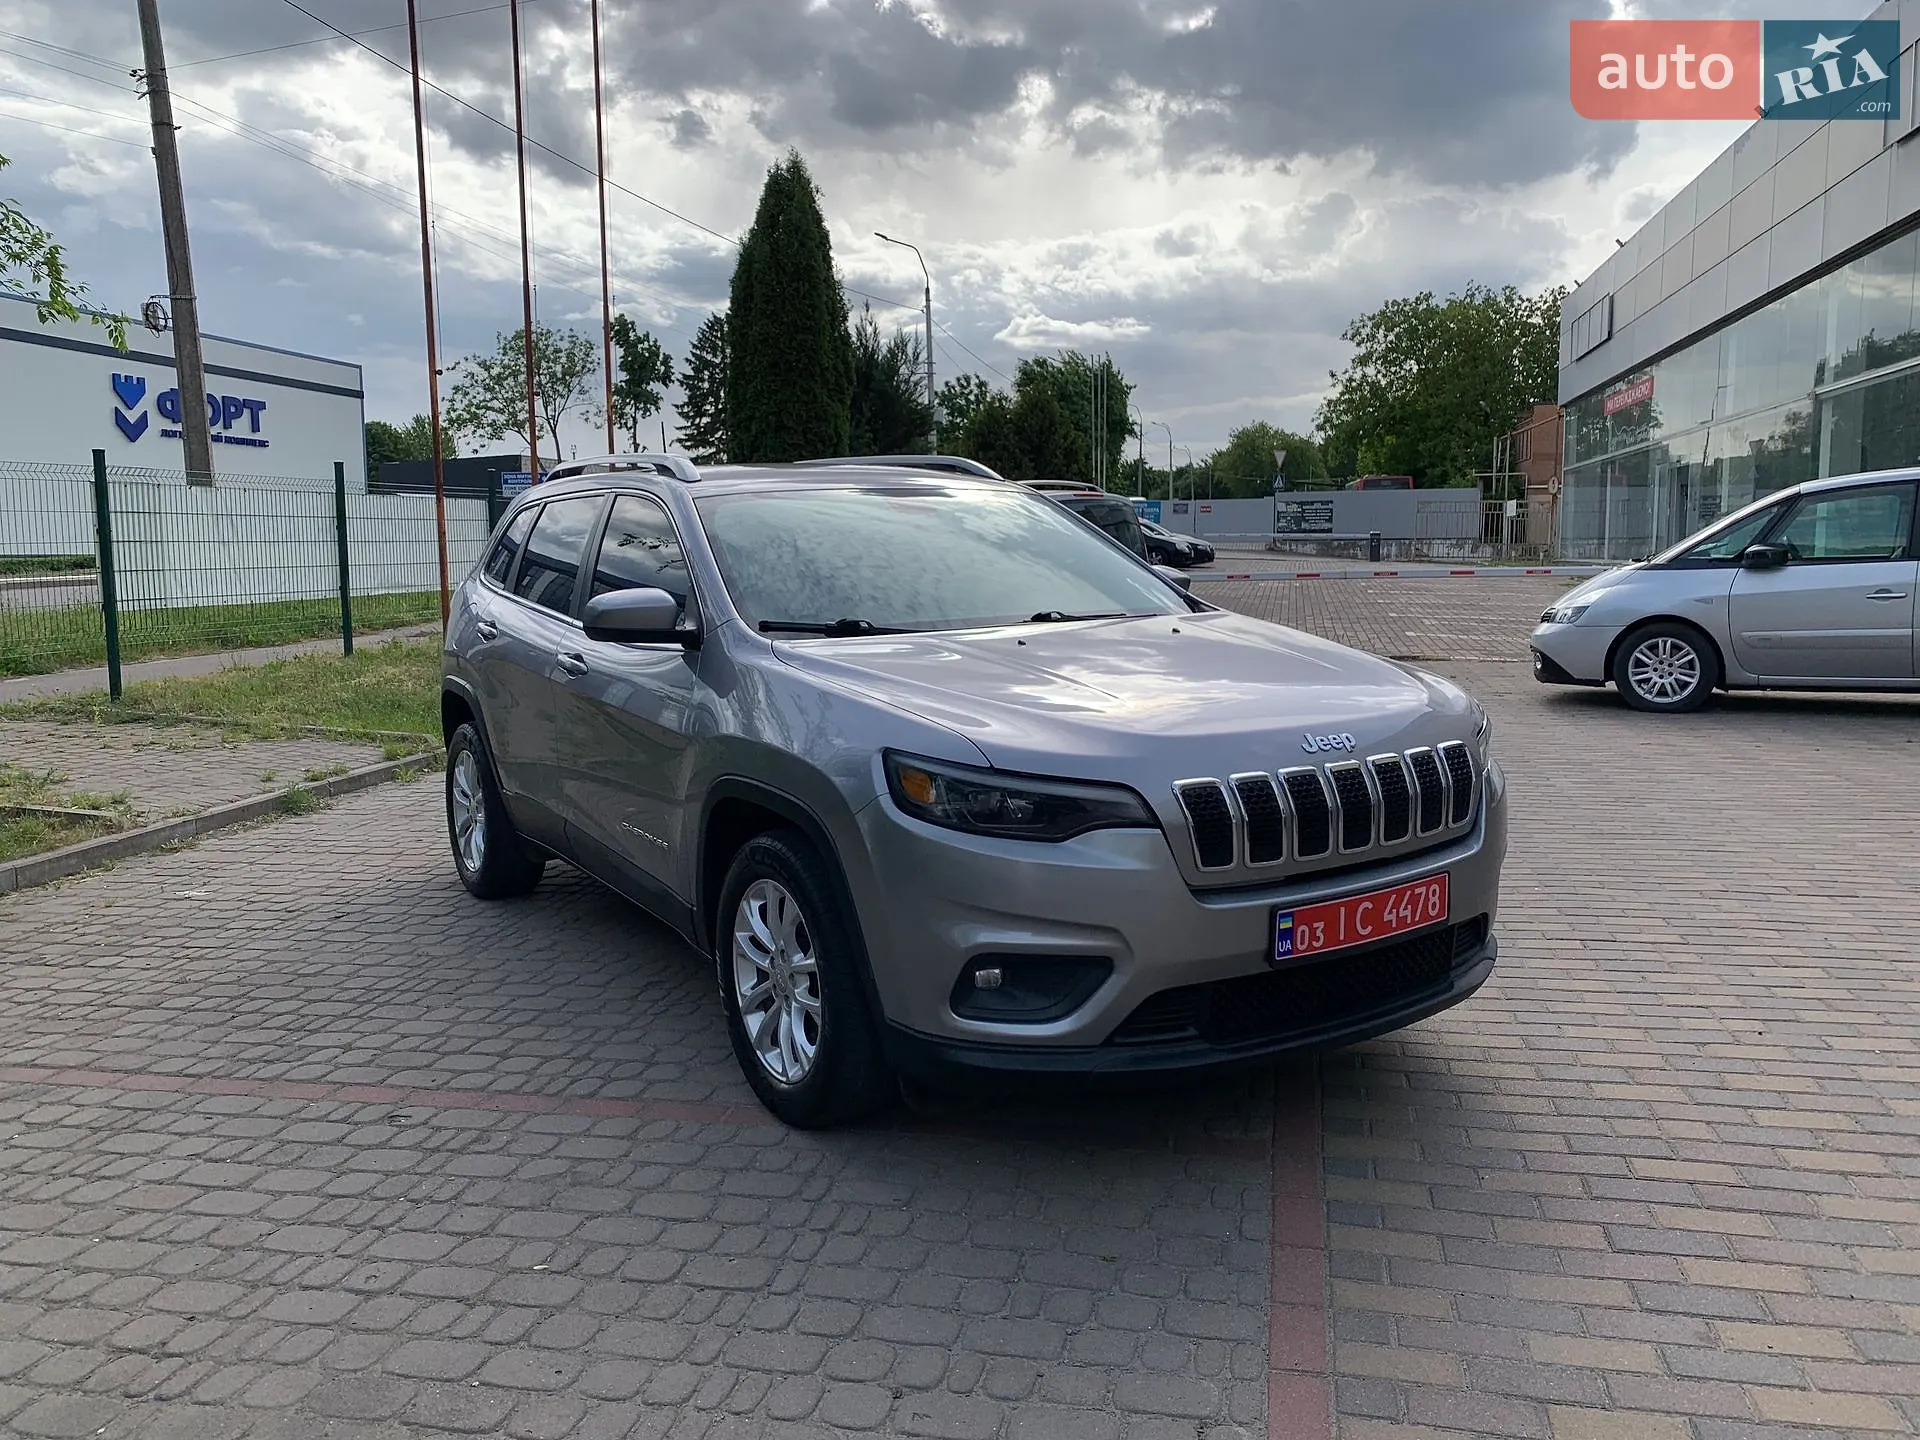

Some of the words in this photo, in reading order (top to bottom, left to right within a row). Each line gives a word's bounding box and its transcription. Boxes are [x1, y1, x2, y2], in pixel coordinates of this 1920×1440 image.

[1301, 732, 1357, 753] Jeep
[1296, 921, 1325, 951] 03
[1383, 883, 1440, 928] 4478
[1279, 939, 1292, 952] UA
